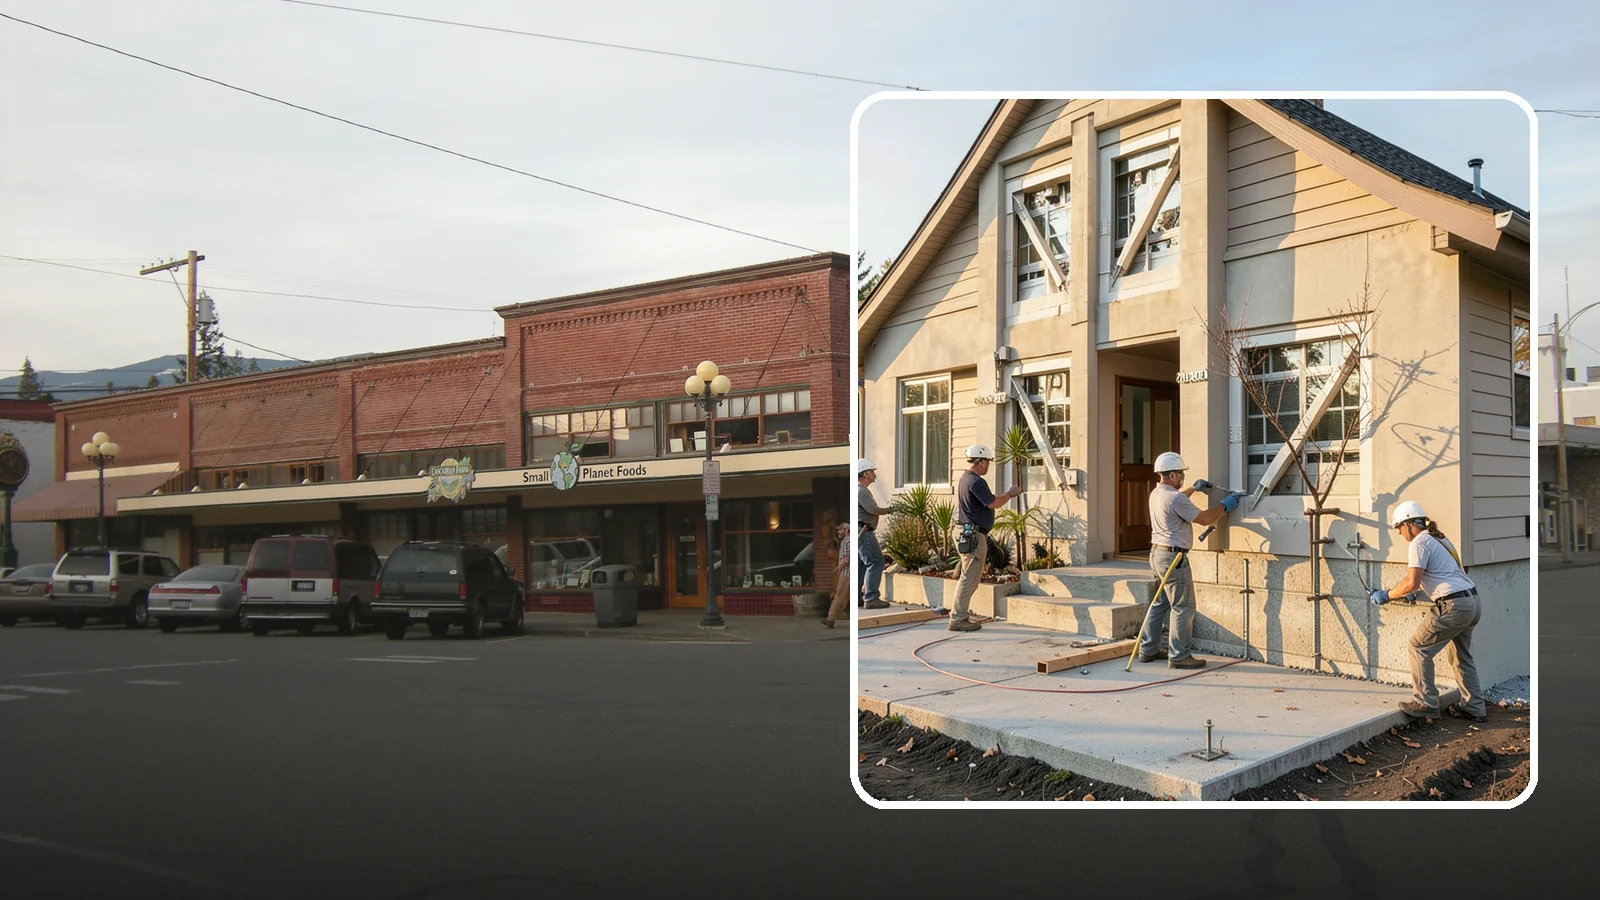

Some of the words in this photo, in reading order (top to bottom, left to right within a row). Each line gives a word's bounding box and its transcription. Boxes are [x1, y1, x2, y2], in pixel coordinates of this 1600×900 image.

[523, 471, 549, 483] Small
[582, 467, 614, 479] Planet
[616, 464, 647, 477] Foods
